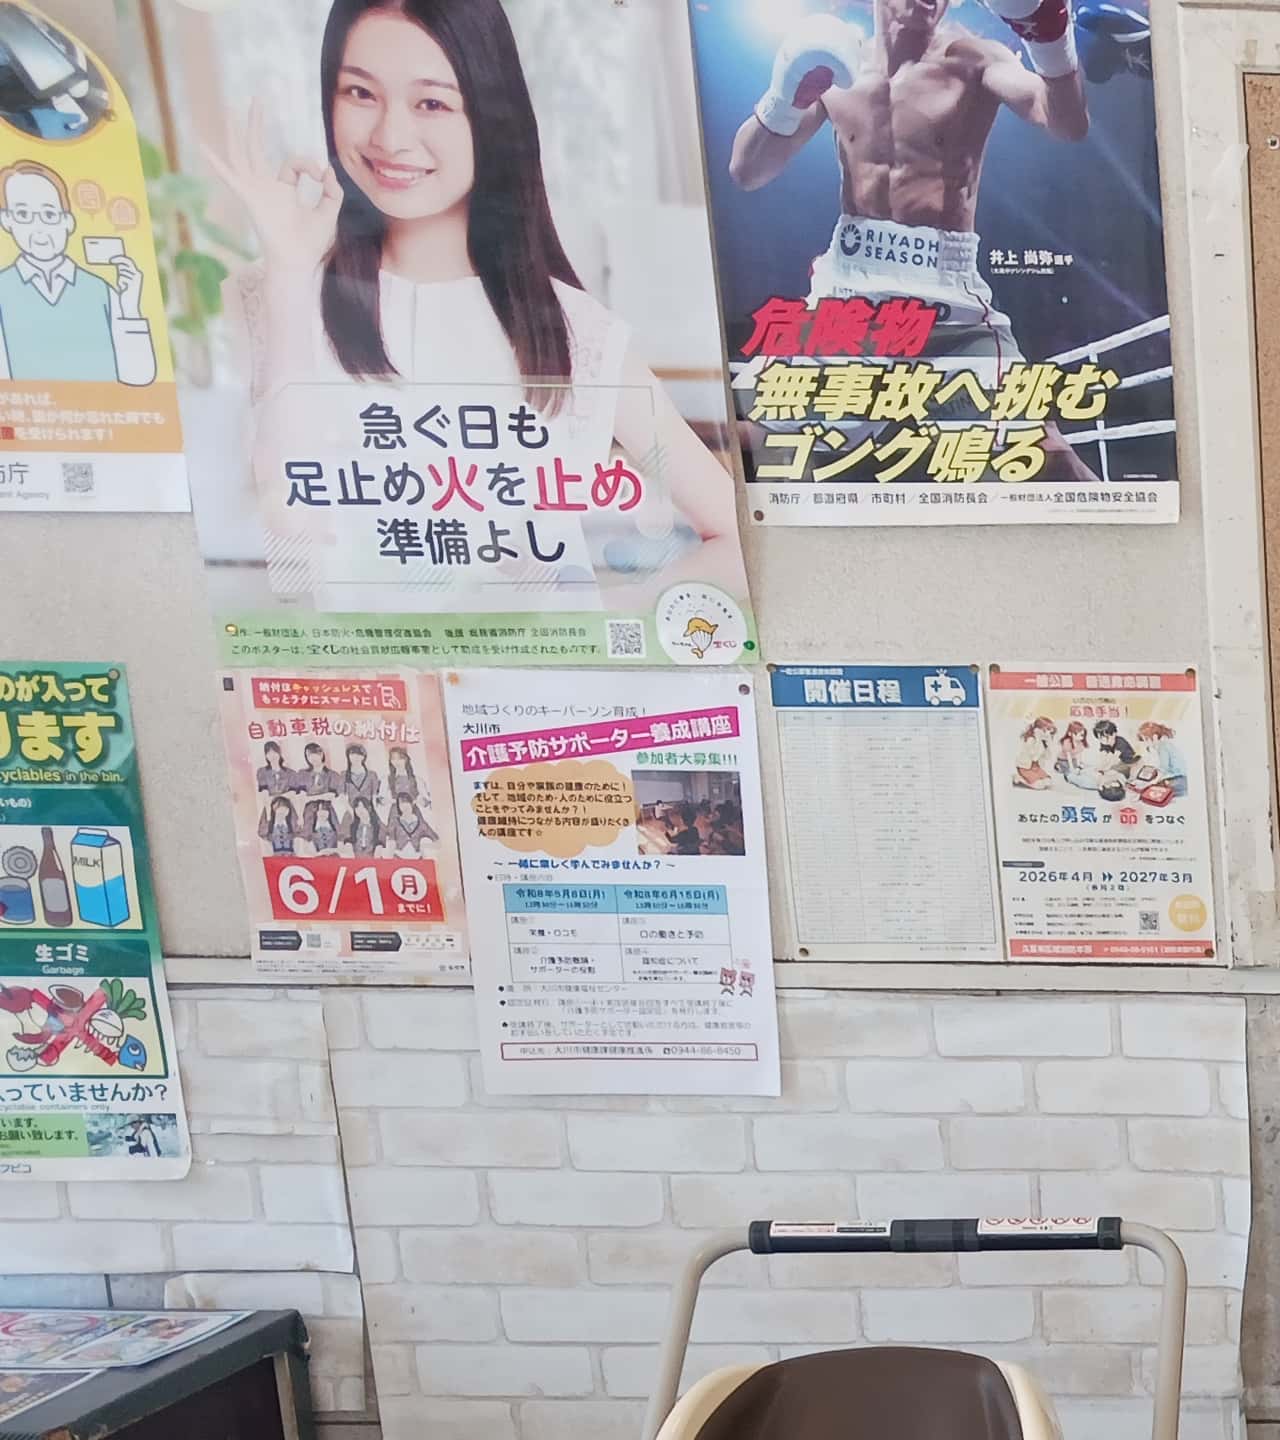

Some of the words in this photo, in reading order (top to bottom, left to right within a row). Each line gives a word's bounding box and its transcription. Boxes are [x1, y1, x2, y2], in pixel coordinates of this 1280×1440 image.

[866, 230, 939, 253] RIYADH
[865, 246, 938, 268] SEASON
[741, 296, 938, 357] 危険物
[748, 362, 1121, 423] 無事故へ挑む
[361, 403, 550, 450] 急ぐ日も
[755, 426, 1047, 483] ゴング鳴る
[286, 455, 644, 513] 足止め火を止め
[871, 492, 906, 504] 市町村
[377, 517, 565, 565] 準備よし
[803, 679, 903, 704] 開催日程
[248, 717, 421, 744] 自動車税の納付は
[463, 723, 501, 734] 大川市
[65, 772, 76, 782] in
[80, 772, 99, 782] the
[101, 771, 125, 783] bin.
[72, 856, 102, 869] MILK
[1018, 871, 1093, 883] 2026年4月
[1119, 871, 1193, 884] 2027年3月
[278, 864, 385, 916] 6/1
[400, 873, 419, 896] 月
[35, 943, 90, 963] 生ゴミ
[42, 964, 85, 975] Garbage
